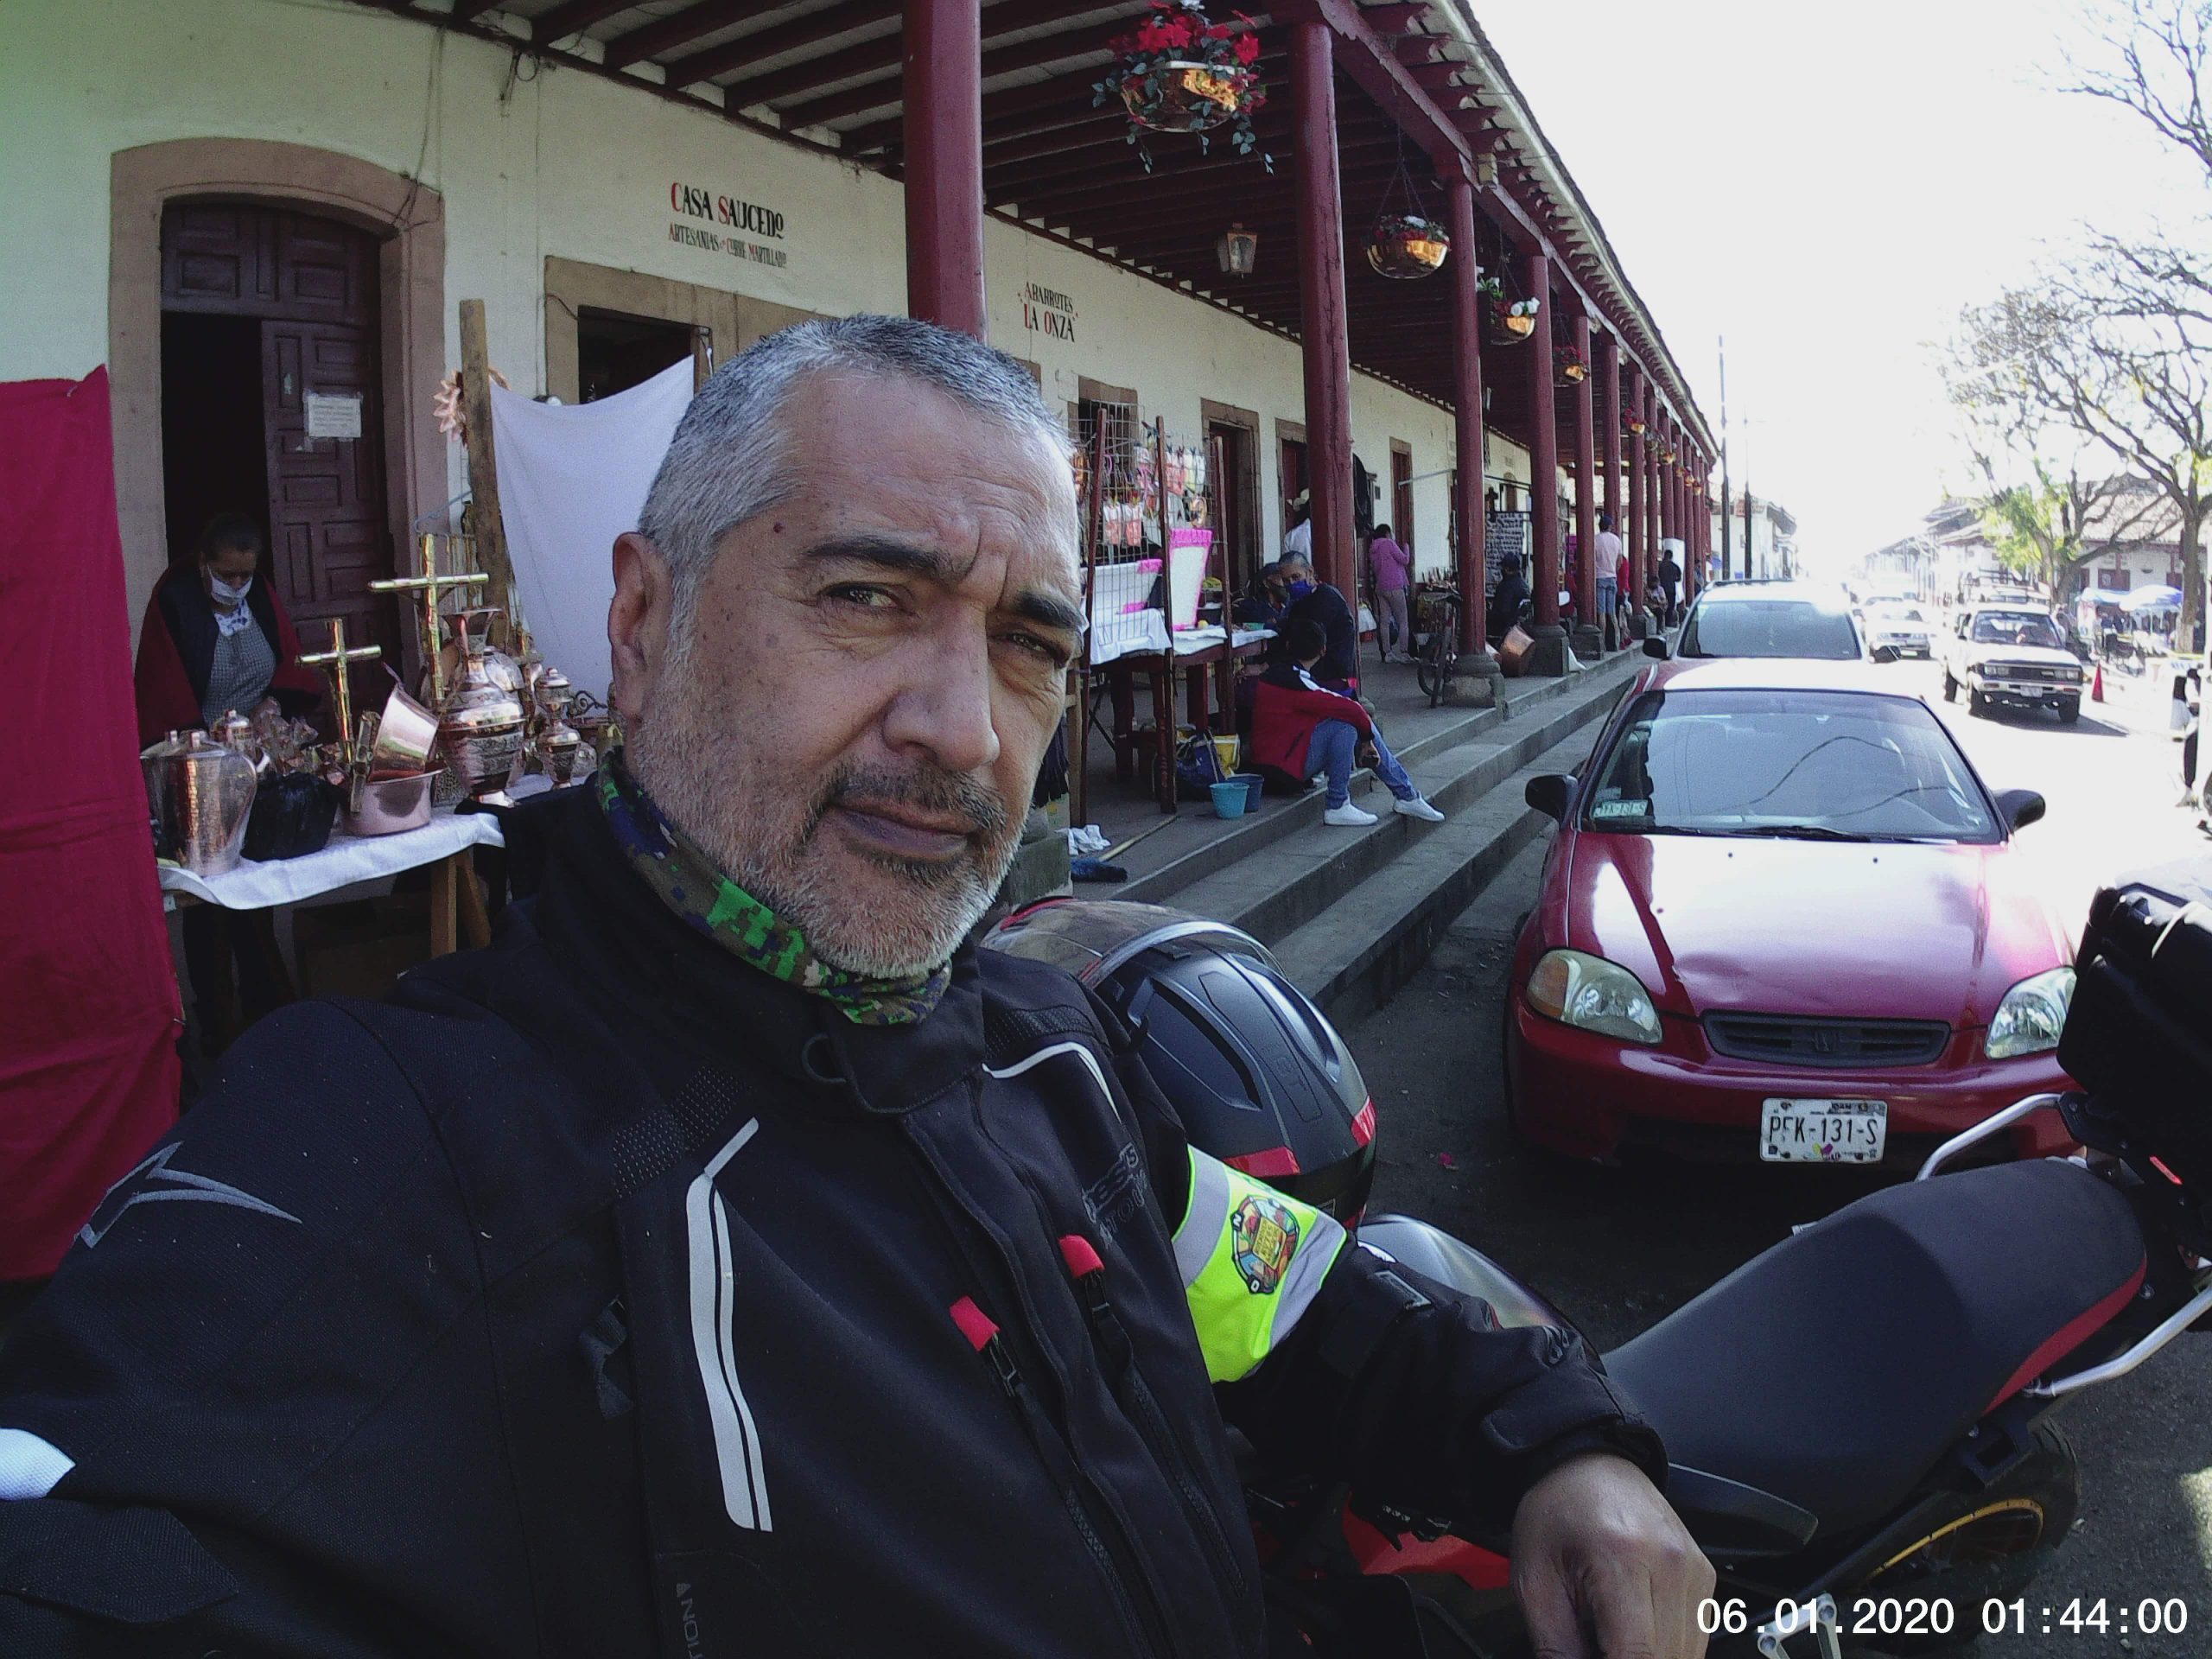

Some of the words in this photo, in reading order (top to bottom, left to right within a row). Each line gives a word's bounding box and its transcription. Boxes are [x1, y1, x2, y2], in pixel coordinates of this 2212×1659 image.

[671, 182, 714, 221] CASA
[718, 195, 785, 239] SAUCEDO
[668, 222, 720, 251] ARTESANIAS
[1025, 281, 1073, 314] ABARROTES
[1024, 303, 1039, 331] LA
[1044, 311, 1075, 343] ONZA
